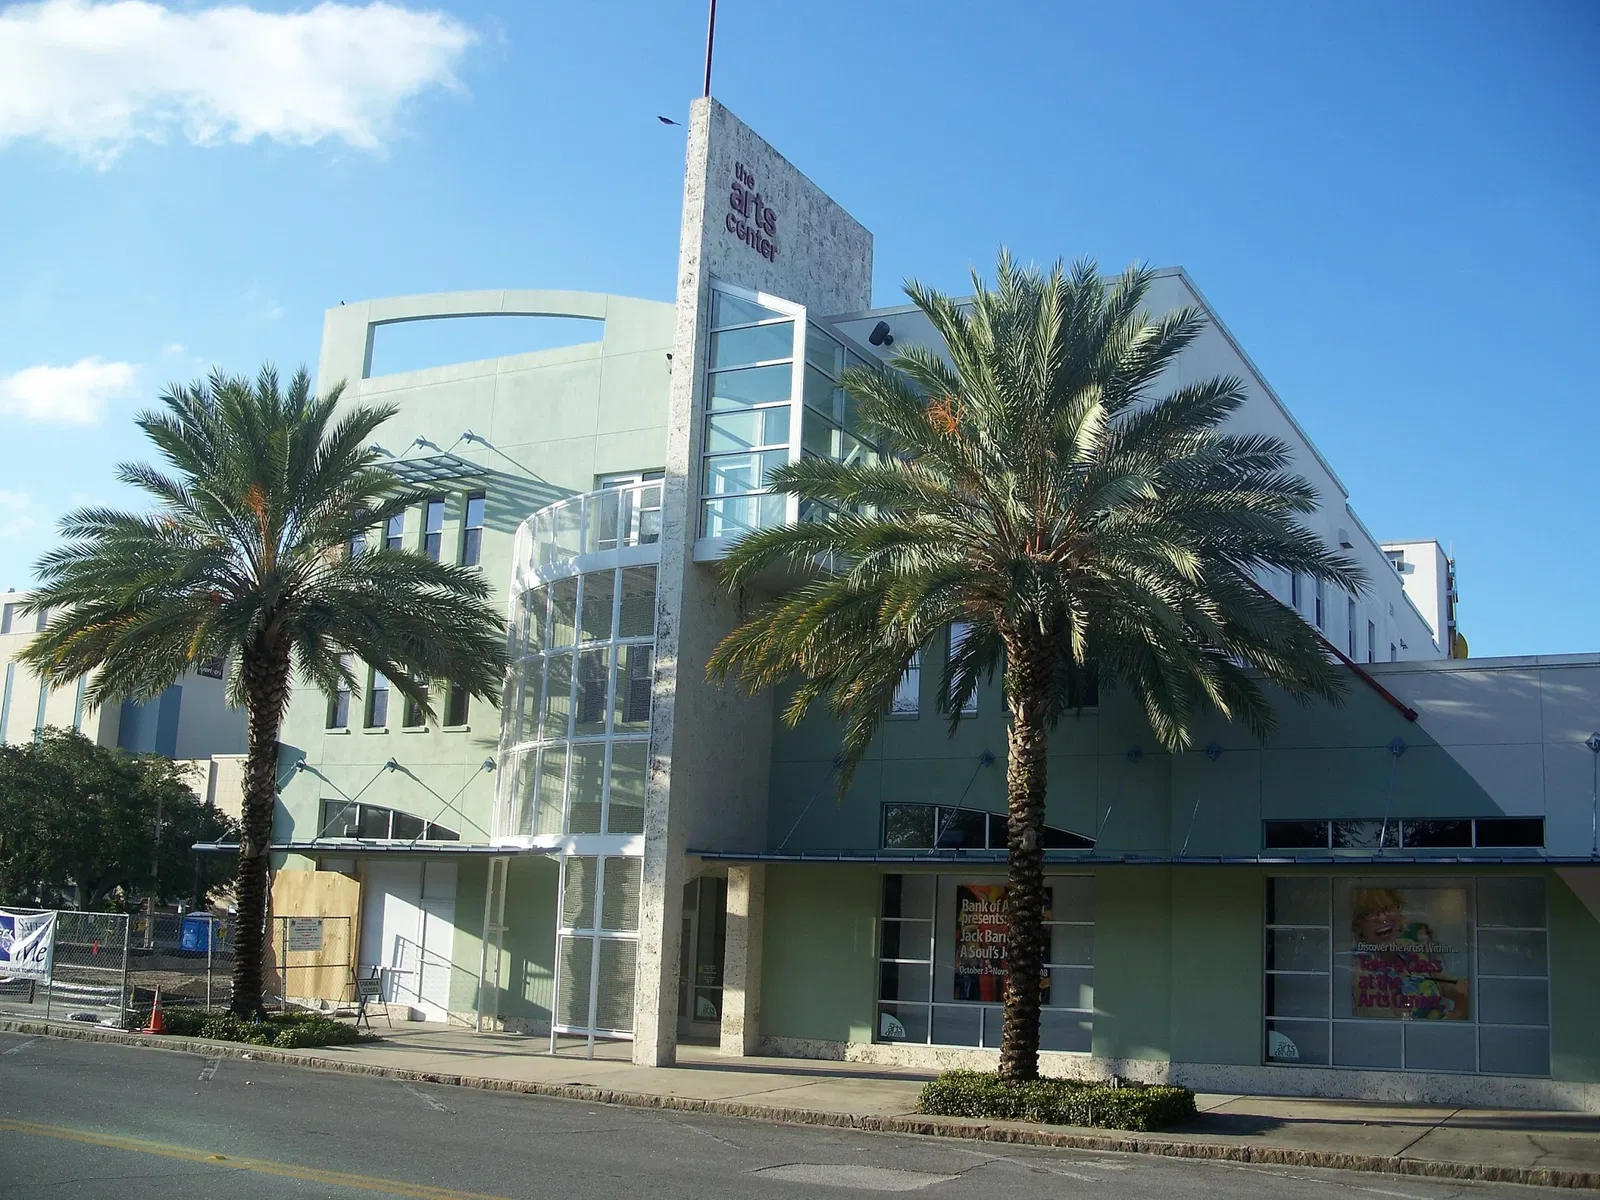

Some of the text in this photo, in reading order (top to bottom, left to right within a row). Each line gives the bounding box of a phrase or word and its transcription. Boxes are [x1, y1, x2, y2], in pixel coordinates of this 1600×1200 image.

[735, 161, 755, 190] the
[730, 180, 777, 237] arts
[725, 213, 777, 263] center
[962, 899, 988, 912] Bank
[989, 900, 1001, 912] of
[961, 912, 1007, 926] presents:
[960, 929, 983, 942] Jack
[16, 940, 47, 962] Me
[960, 945, 967, 957] A
[969, 945, 999, 958] Soul's
[1357, 942, 1388, 951] Discover
[1389, 943, 1402, 952] the
[1403, 943, 1424, 952] Artist
[959, 966, 983, 974] October
[1405, 954, 1442, 973] Class
[1358, 974, 1401, 992] at the
[1358, 990, 1390, 1008] Arts
[1278, 1044, 1295, 1052] arts
